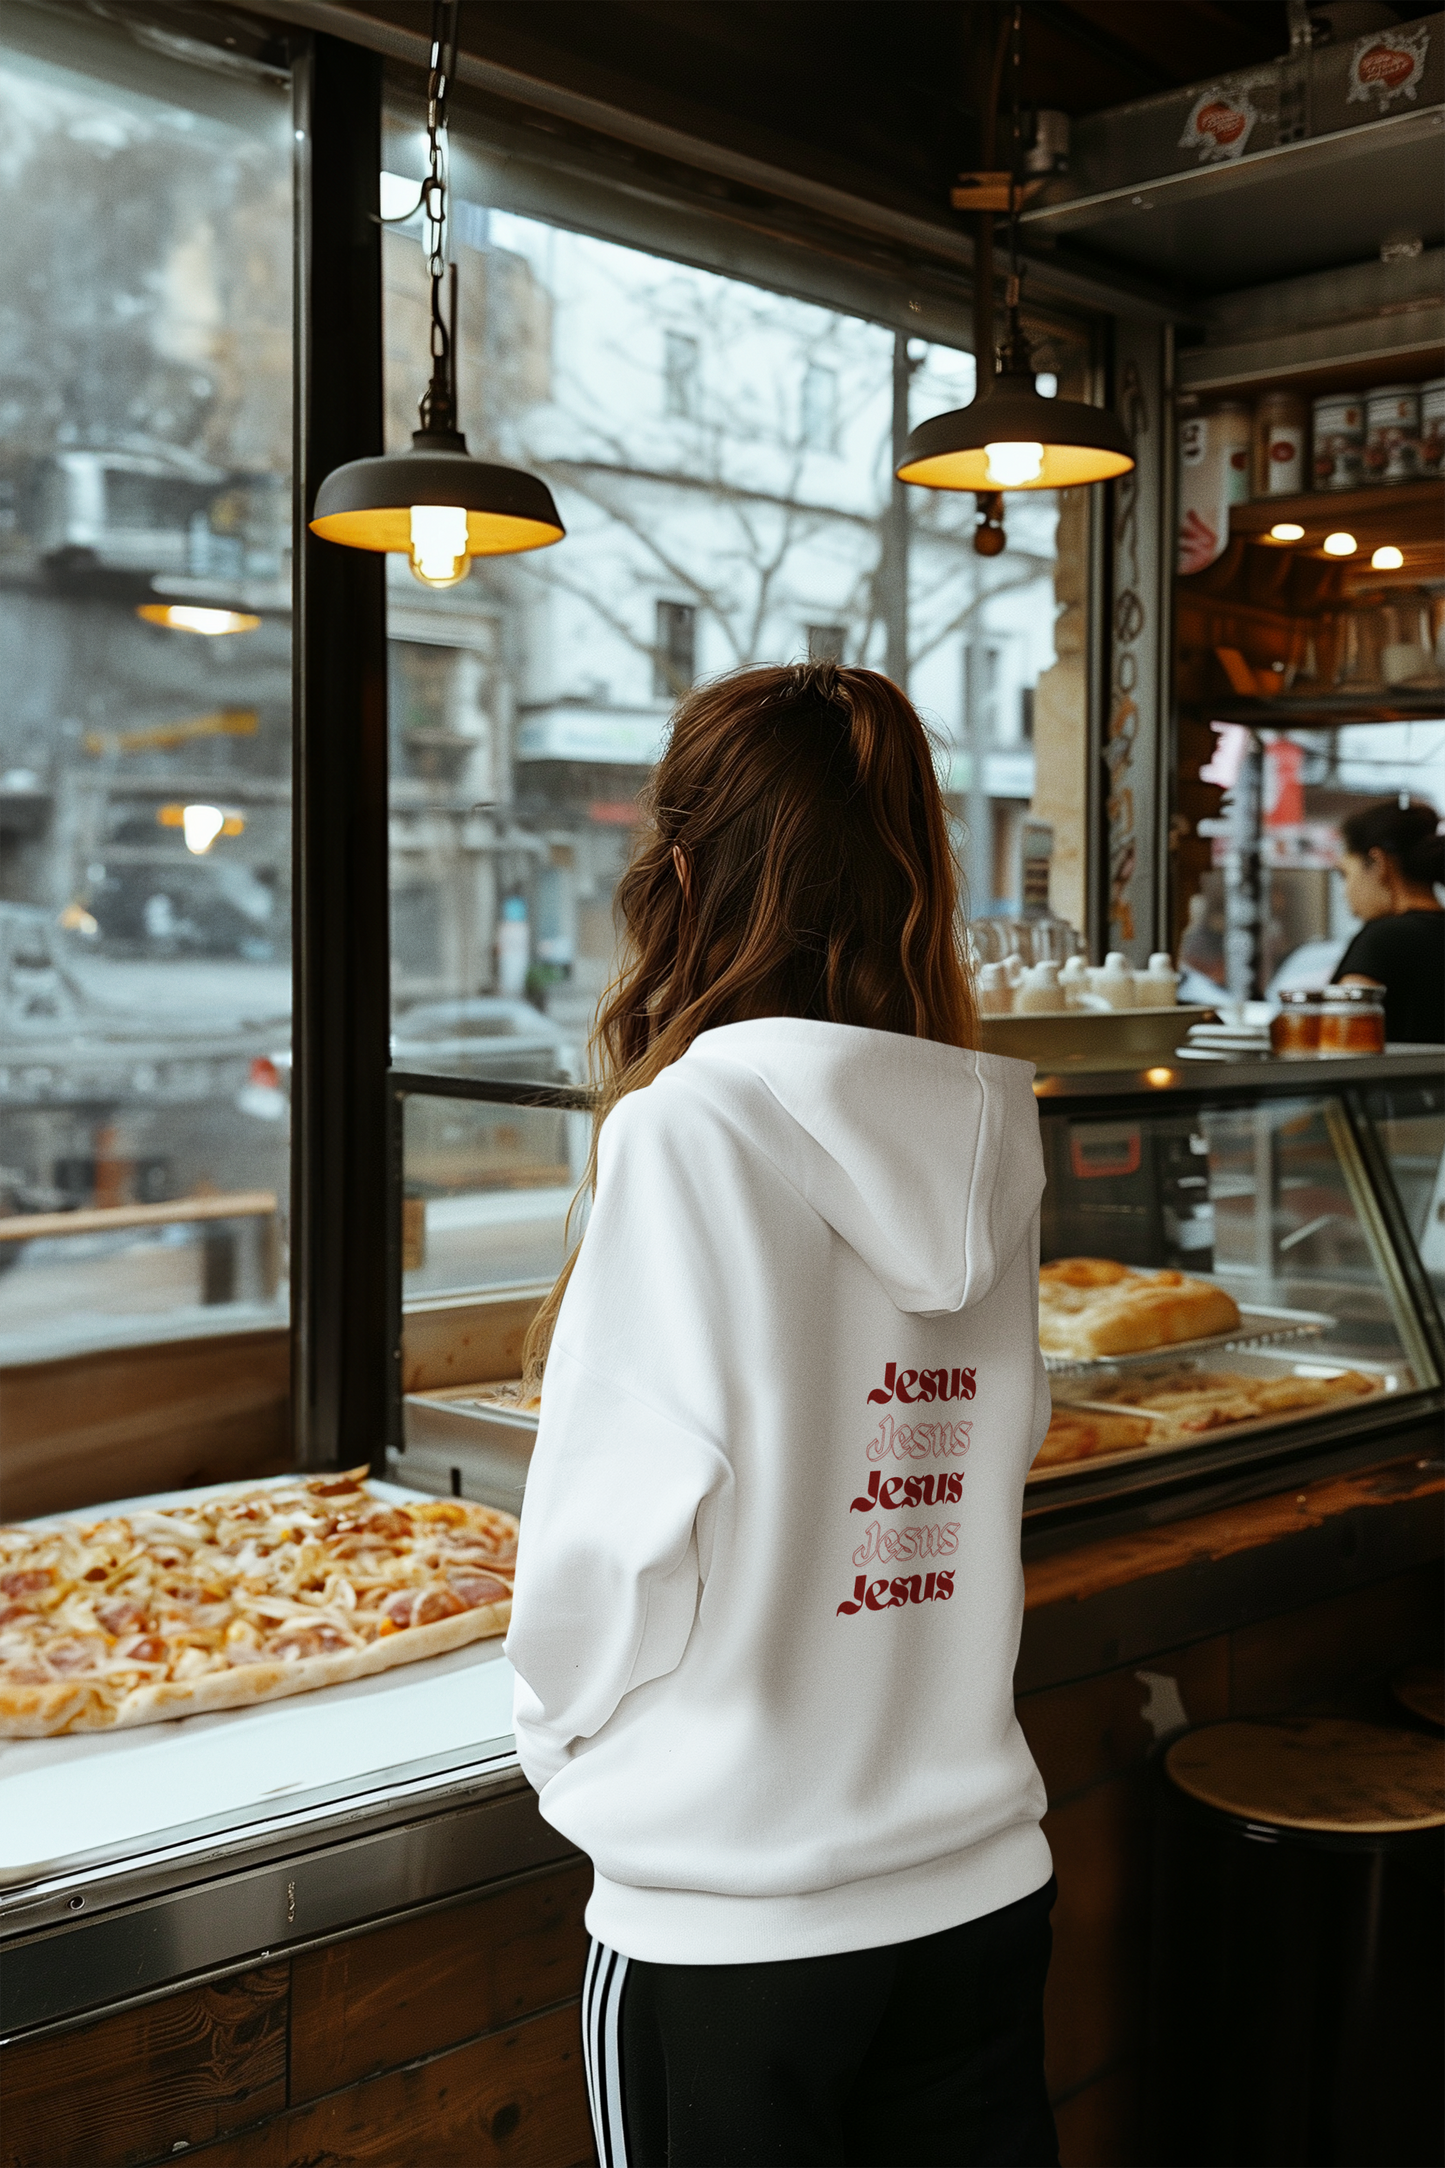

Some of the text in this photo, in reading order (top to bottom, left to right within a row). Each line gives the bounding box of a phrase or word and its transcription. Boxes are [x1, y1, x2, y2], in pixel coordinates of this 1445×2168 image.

[867, 1362, 977, 1404] Jesus
[866, 1414, 974, 1462] Jesus
[849, 1470, 965, 1513] Jesus
[852, 1520, 961, 1568] Jesus
[836, 1569, 956, 1617] Jesus
